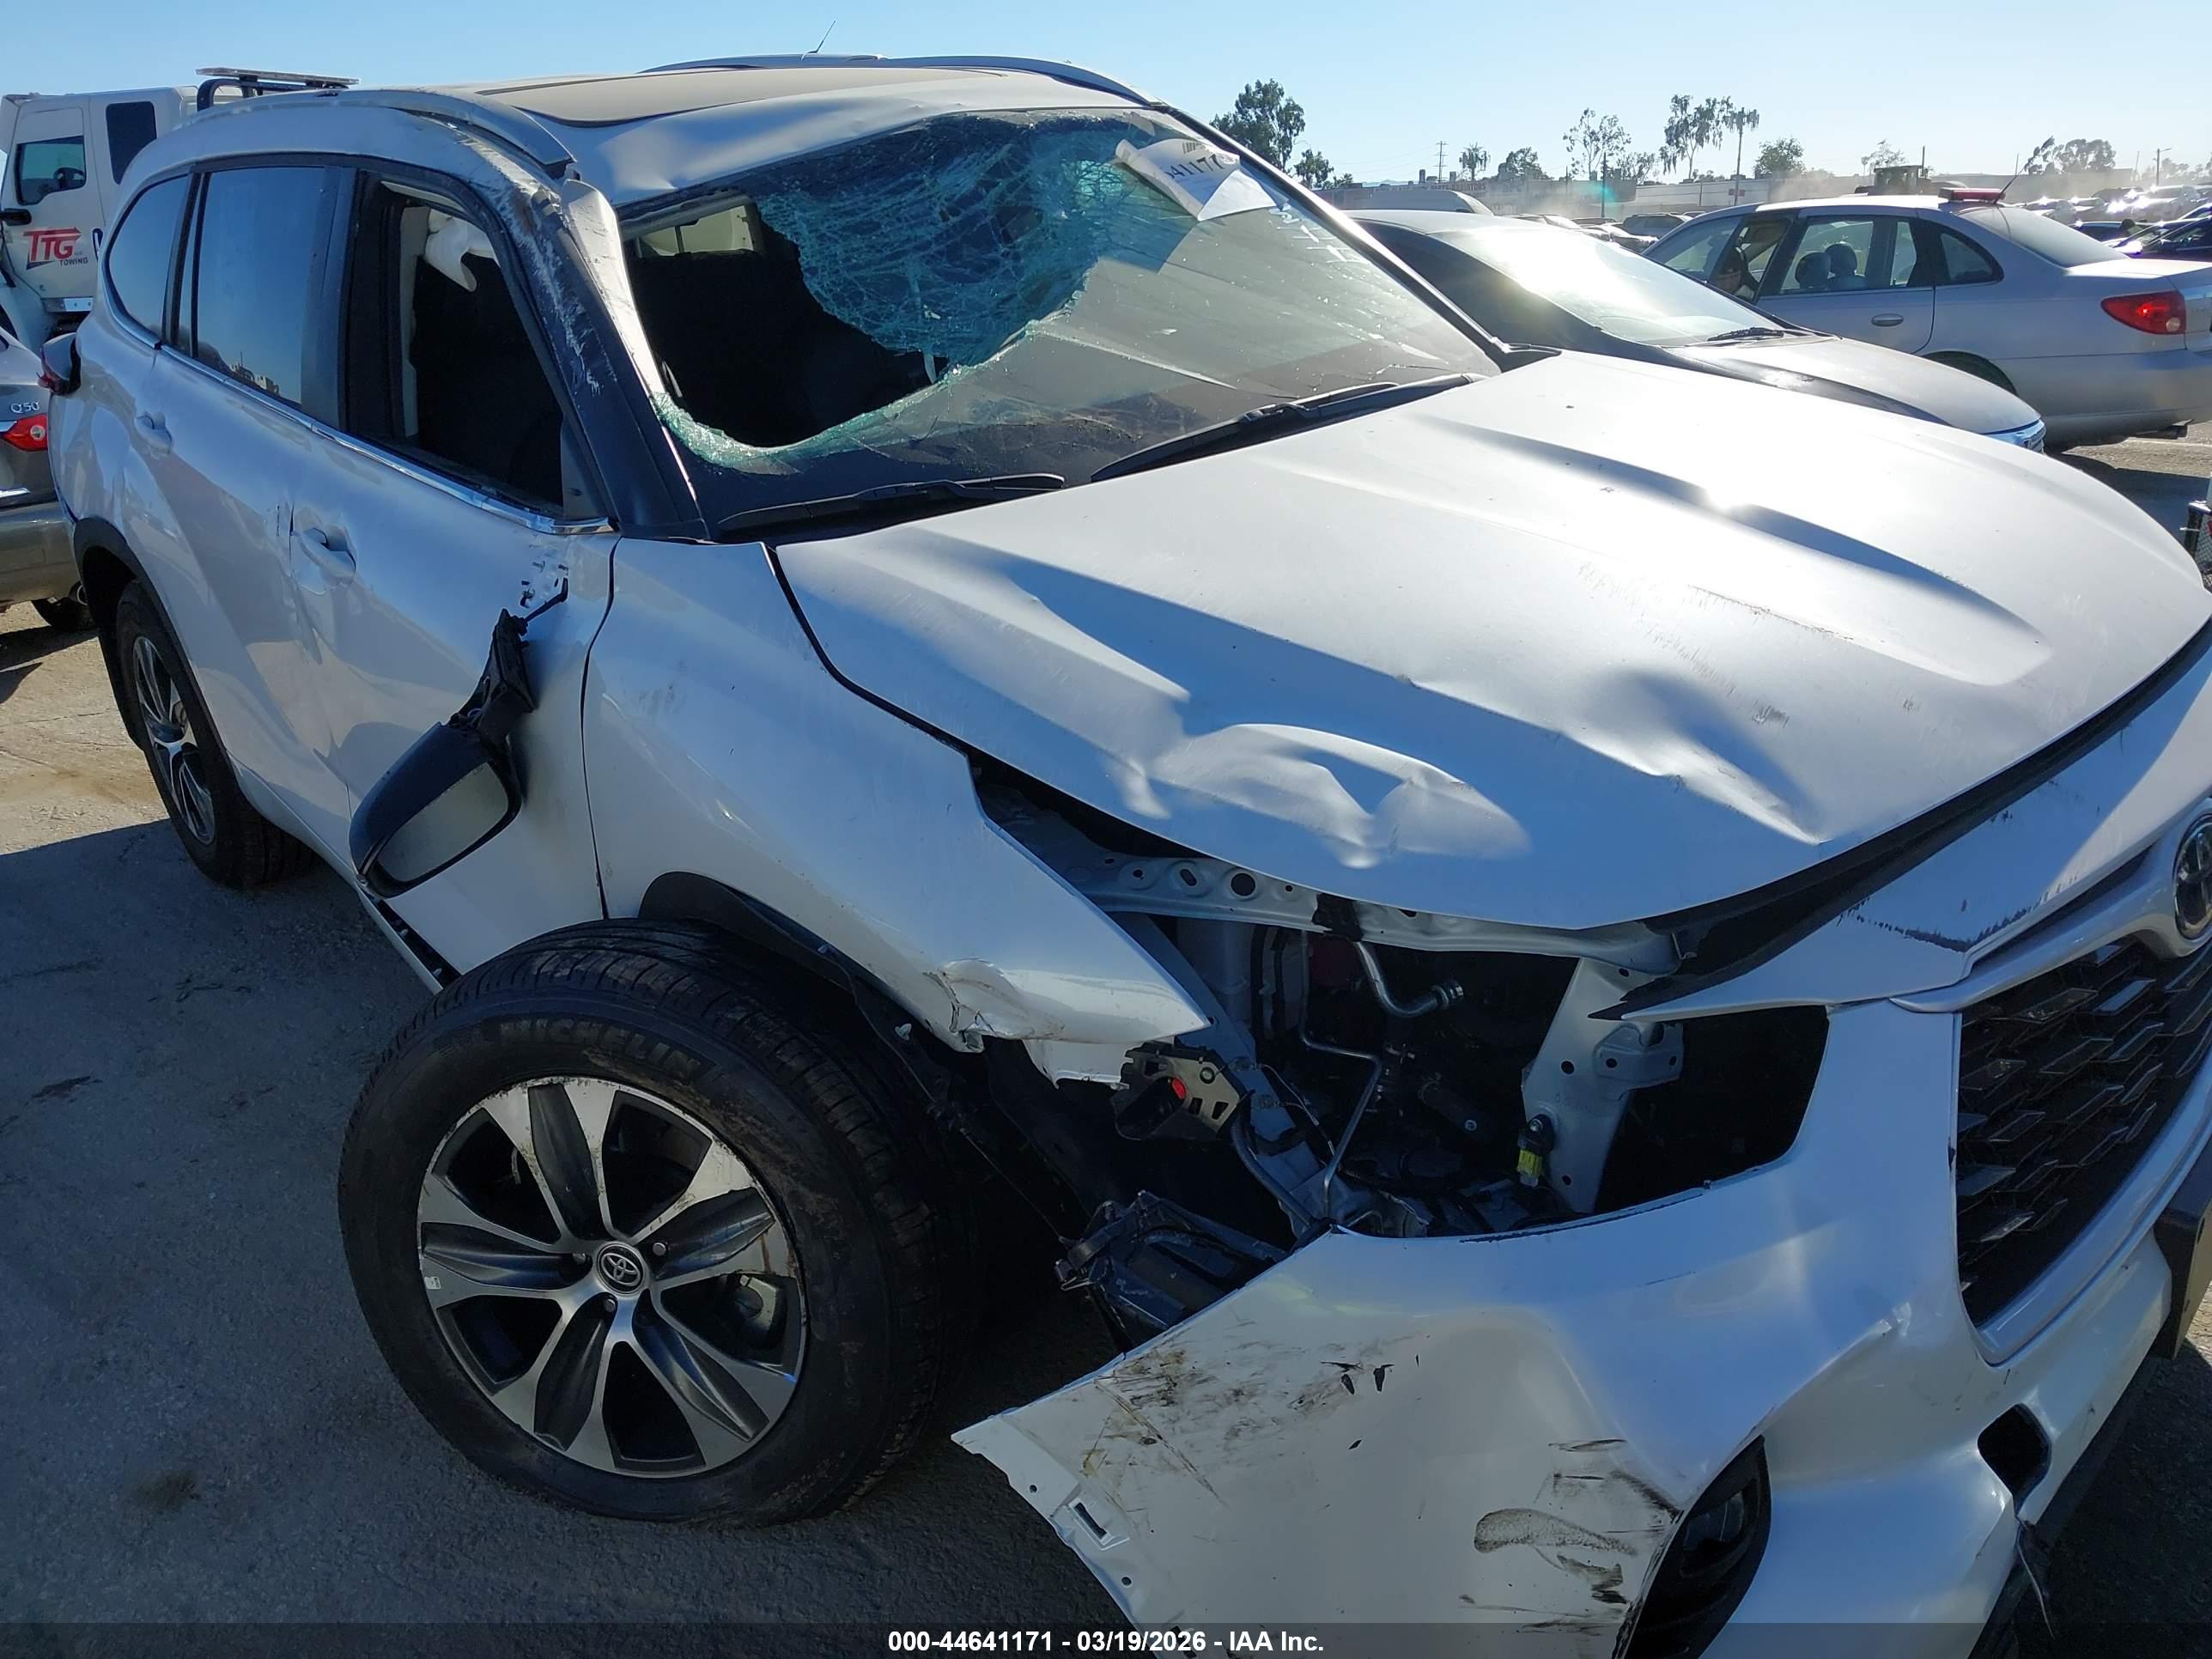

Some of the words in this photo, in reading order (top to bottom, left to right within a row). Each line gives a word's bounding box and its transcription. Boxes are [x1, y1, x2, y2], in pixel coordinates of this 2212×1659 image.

[23, 227, 82, 262] TTG
[59, 257, 88, 266] TOWING
[10, 402, 40, 414] Q50
[500, 1017, 704, 1078] MICHELIN
